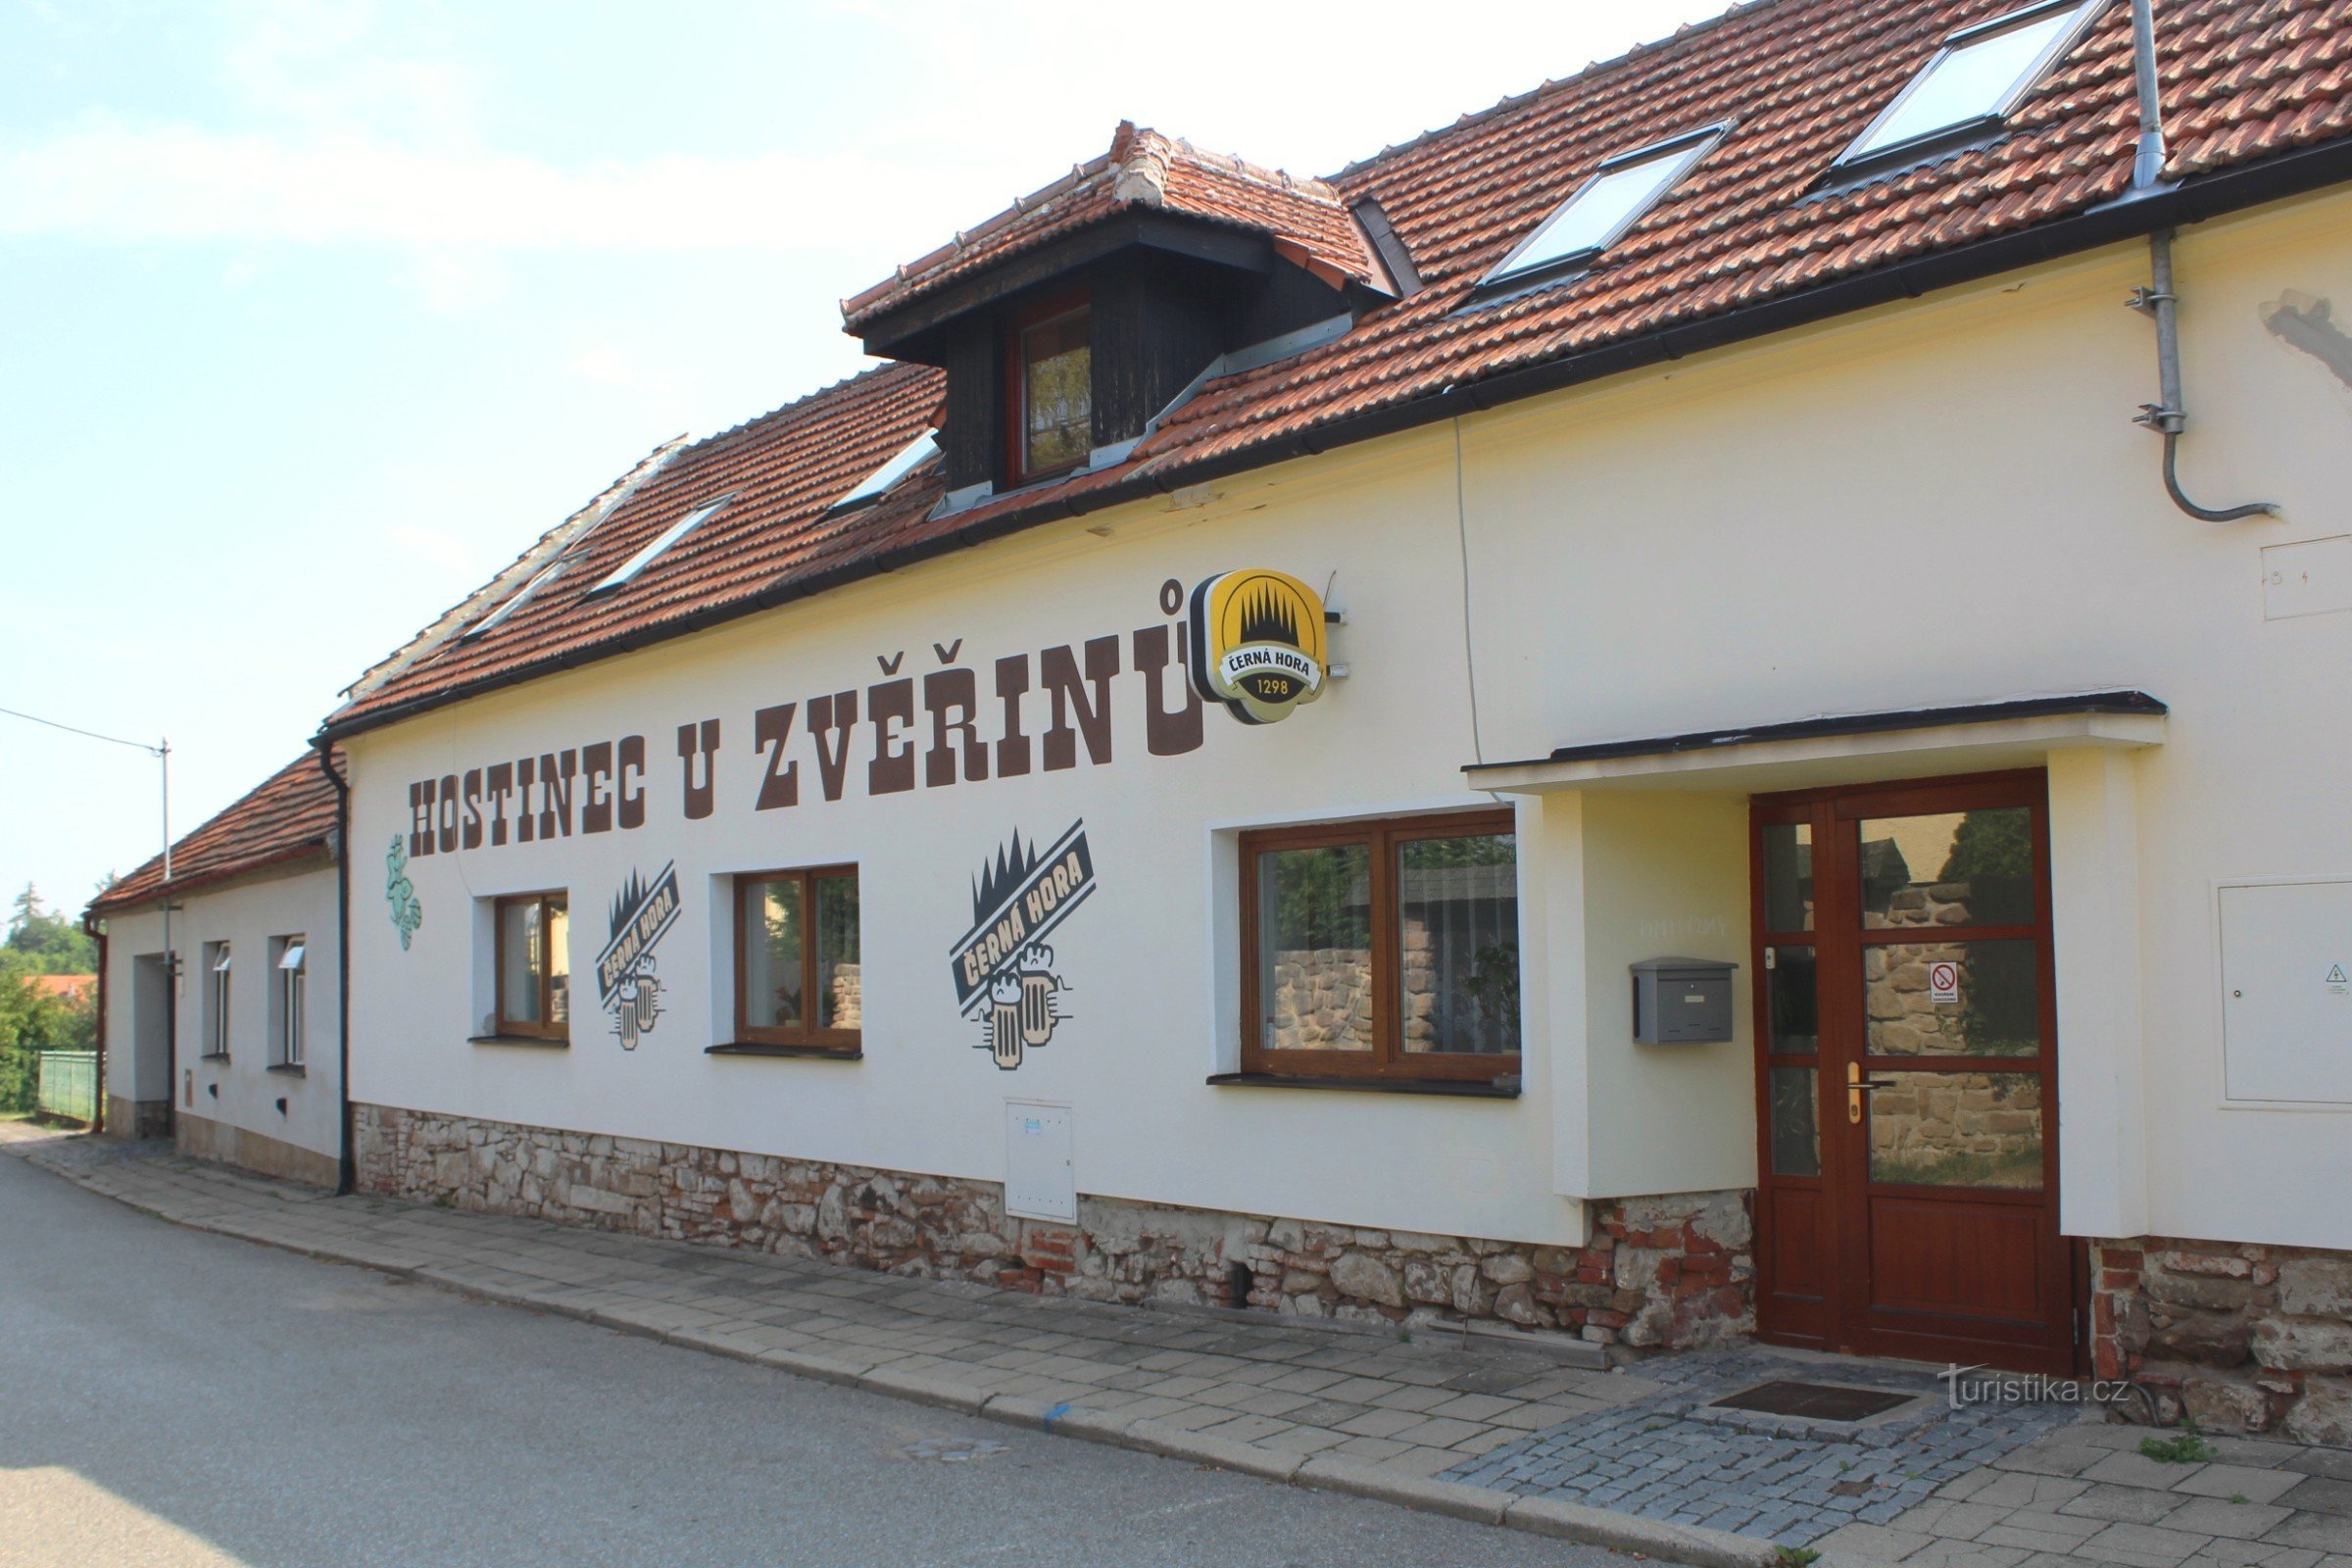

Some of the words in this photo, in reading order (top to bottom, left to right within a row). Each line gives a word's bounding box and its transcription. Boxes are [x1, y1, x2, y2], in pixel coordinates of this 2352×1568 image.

[1228, 648, 1272, 672] ČERNÁ
[1275, 651, 1309, 676] HORA
[1257, 678, 1289, 695] 1298
[410, 735, 645, 858] HOSTINEC
[677, 718, 720, 820] U
[755, 578, 1204, 811] ZVĚŘINŮ
[603, 923, 641, 988] ČERNÁ
[640, 886, 673, 941] HORA
[963, 901, 1026, 987] ČERNÁ
[1026, 851, 1084, 924] HORA
